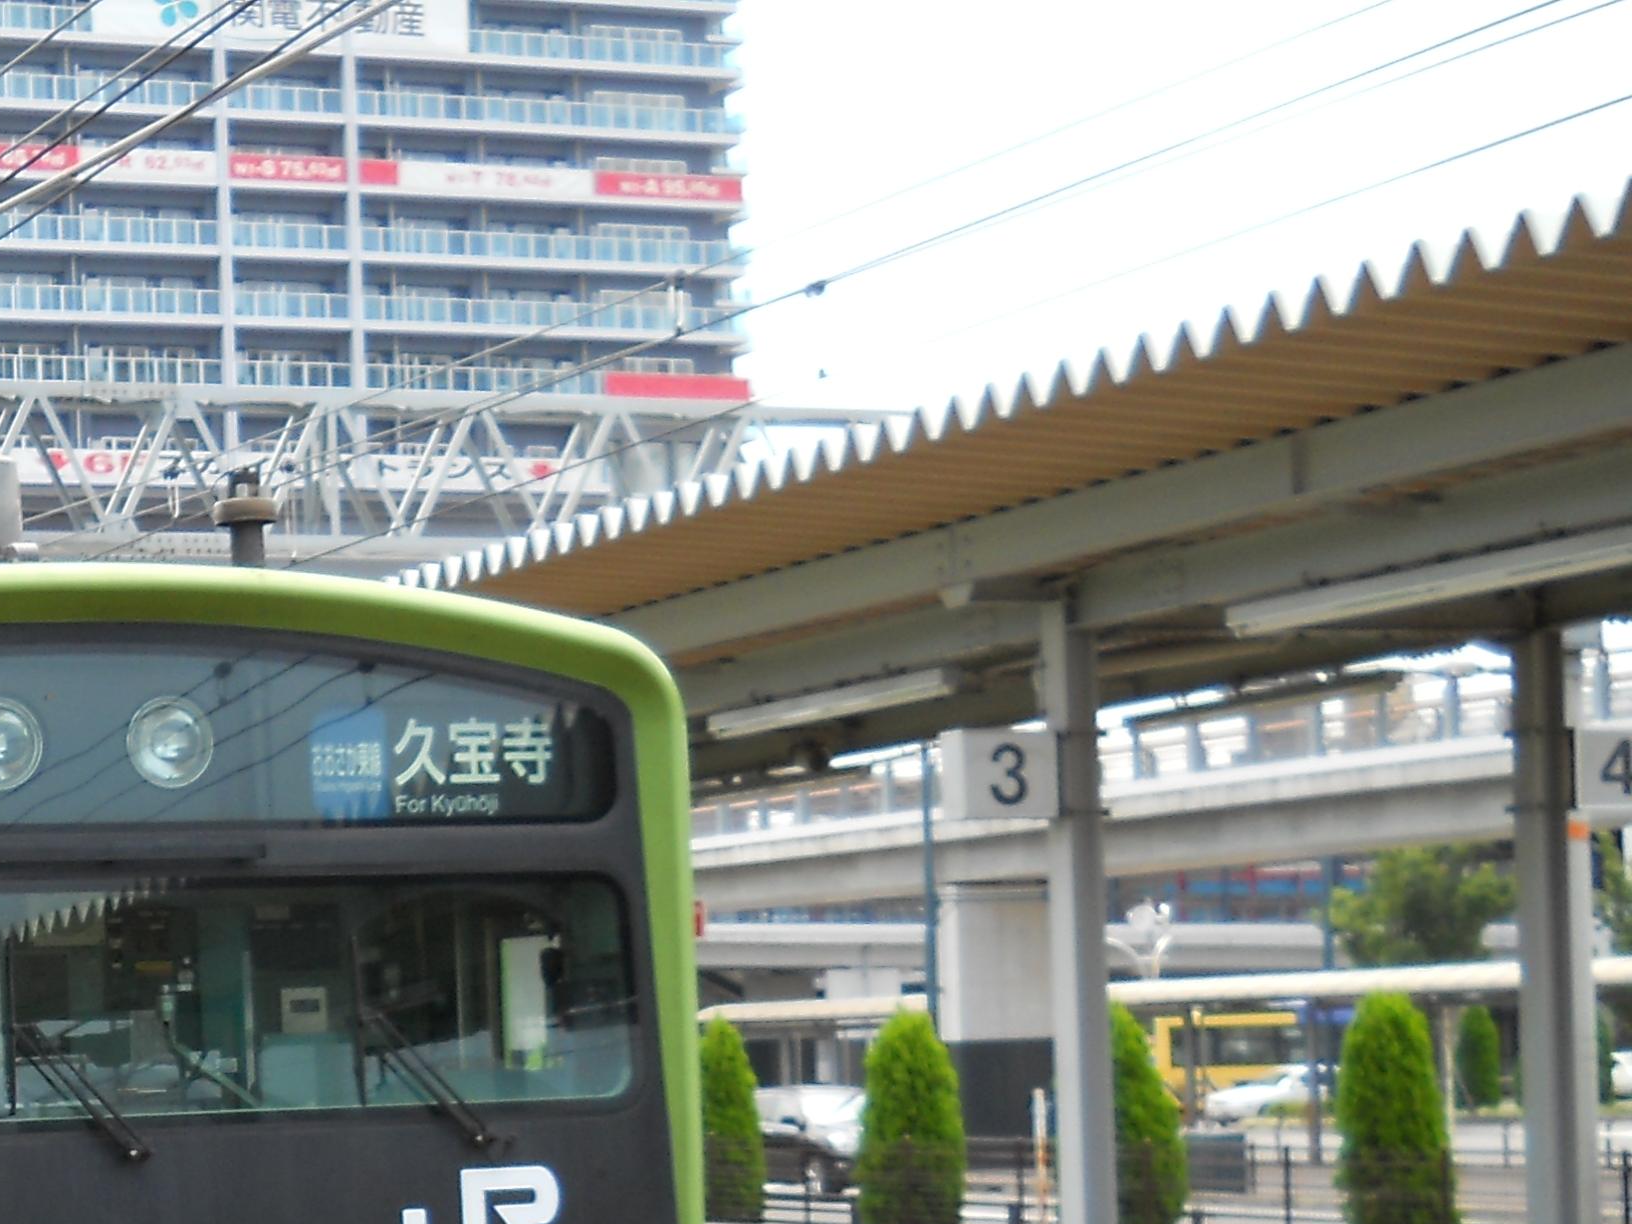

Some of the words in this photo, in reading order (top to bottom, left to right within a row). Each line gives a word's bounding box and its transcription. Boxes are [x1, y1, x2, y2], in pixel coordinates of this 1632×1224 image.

[394, 717, 552, 785] 久宝寺
[990, 743, 1029, 806] 3
[1600, 739, 1632, 794] 4
[395, 795, 426, 813] For
